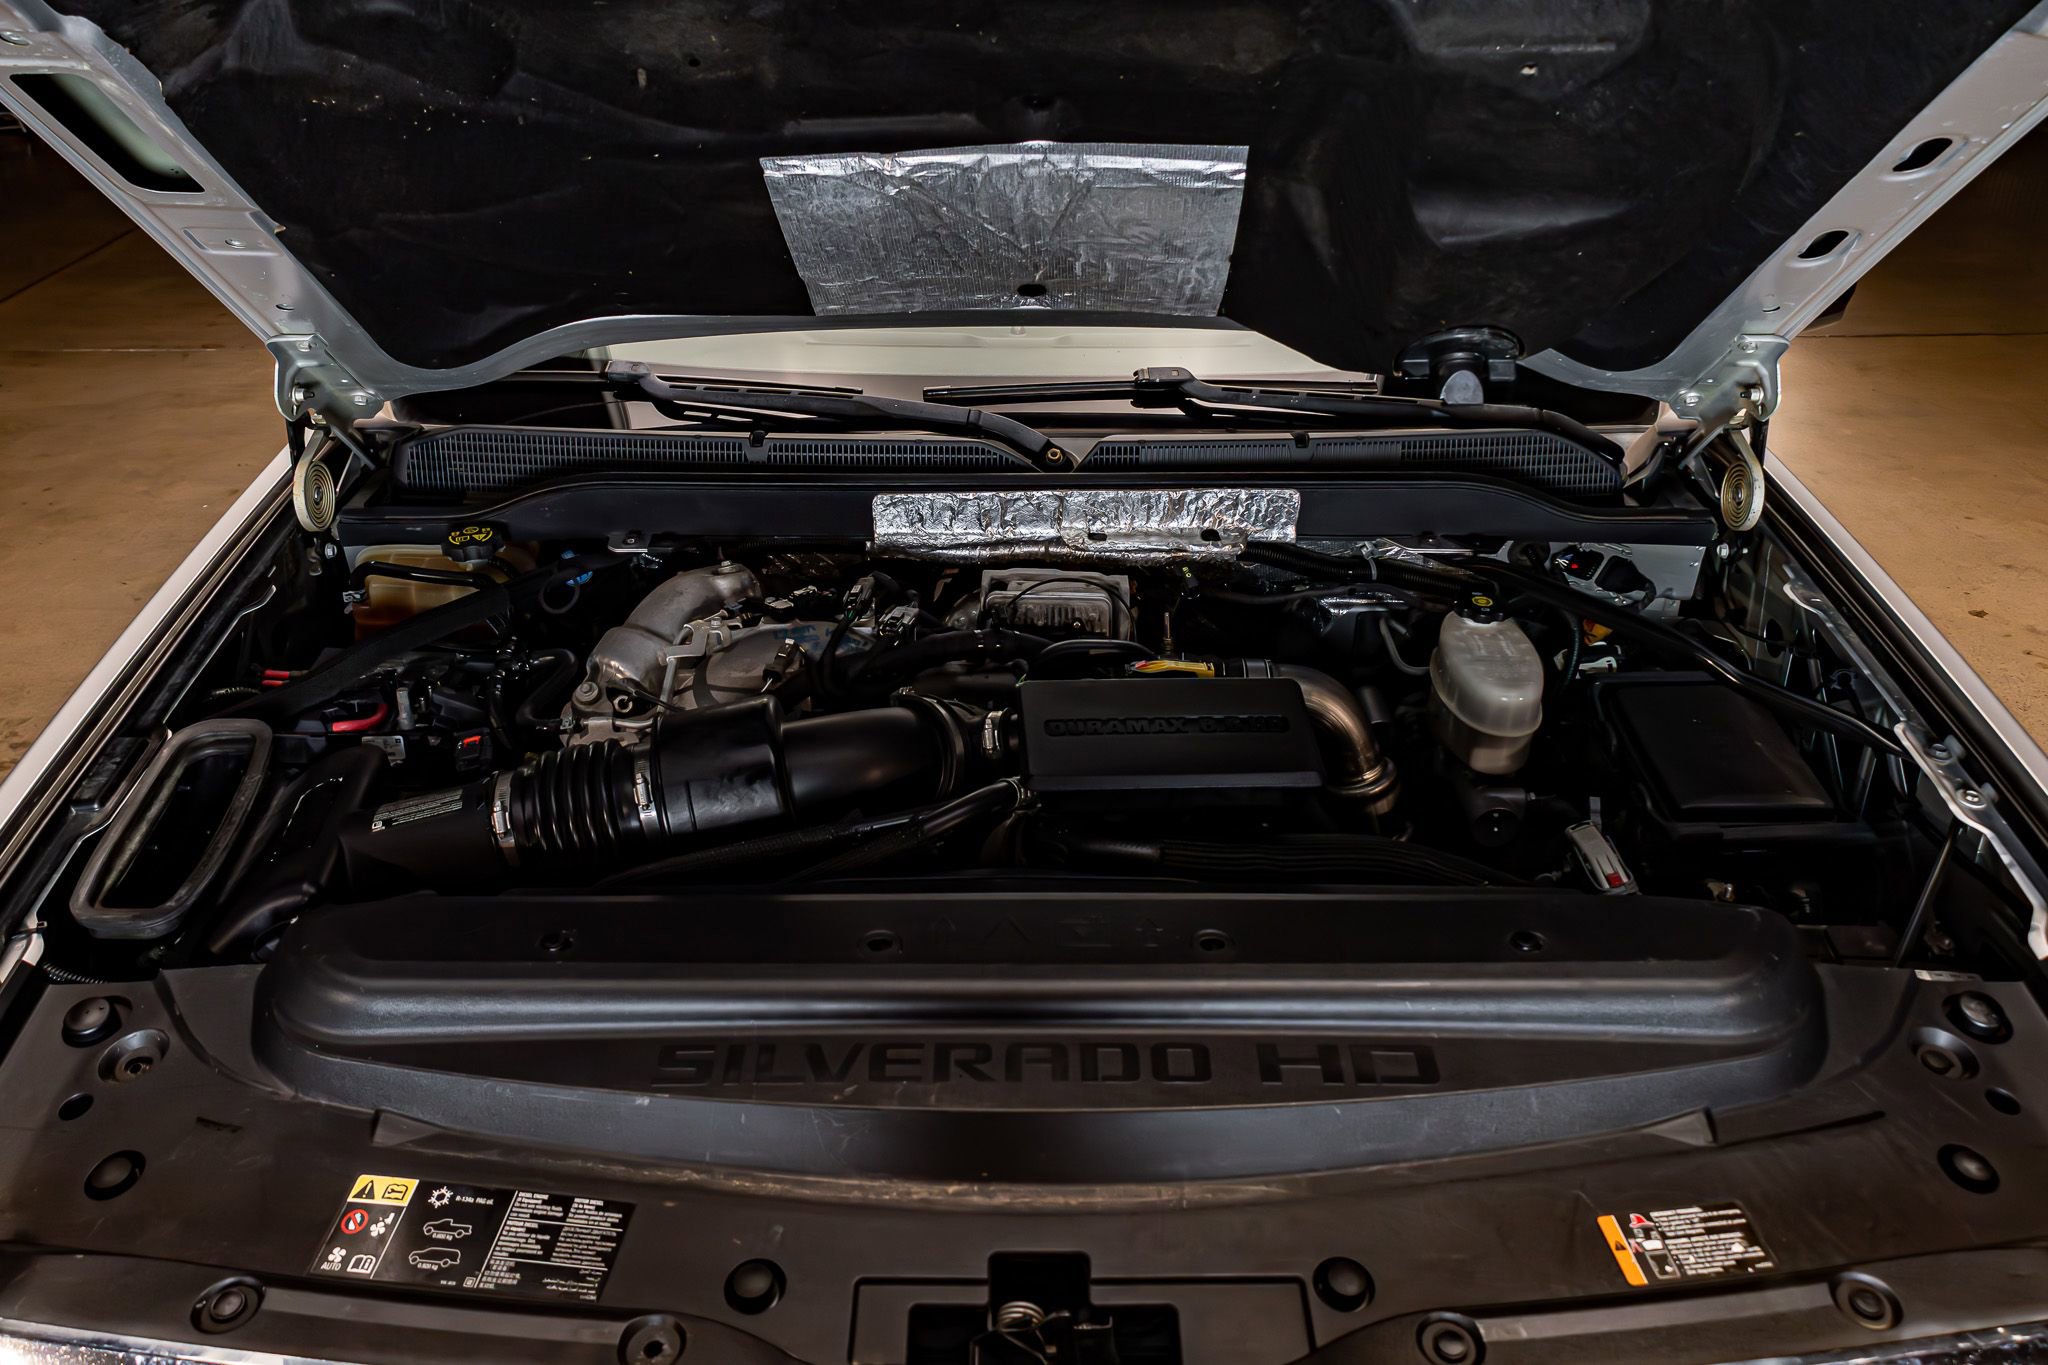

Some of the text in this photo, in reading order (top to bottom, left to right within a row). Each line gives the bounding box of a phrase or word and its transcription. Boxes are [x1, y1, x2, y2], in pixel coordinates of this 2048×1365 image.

[1045, 718, 1189, 736] DURAMAX
[650, 1042, 1443, 1088] SILVERADO HD
[320, 1261, 343, 1272] AUTO
